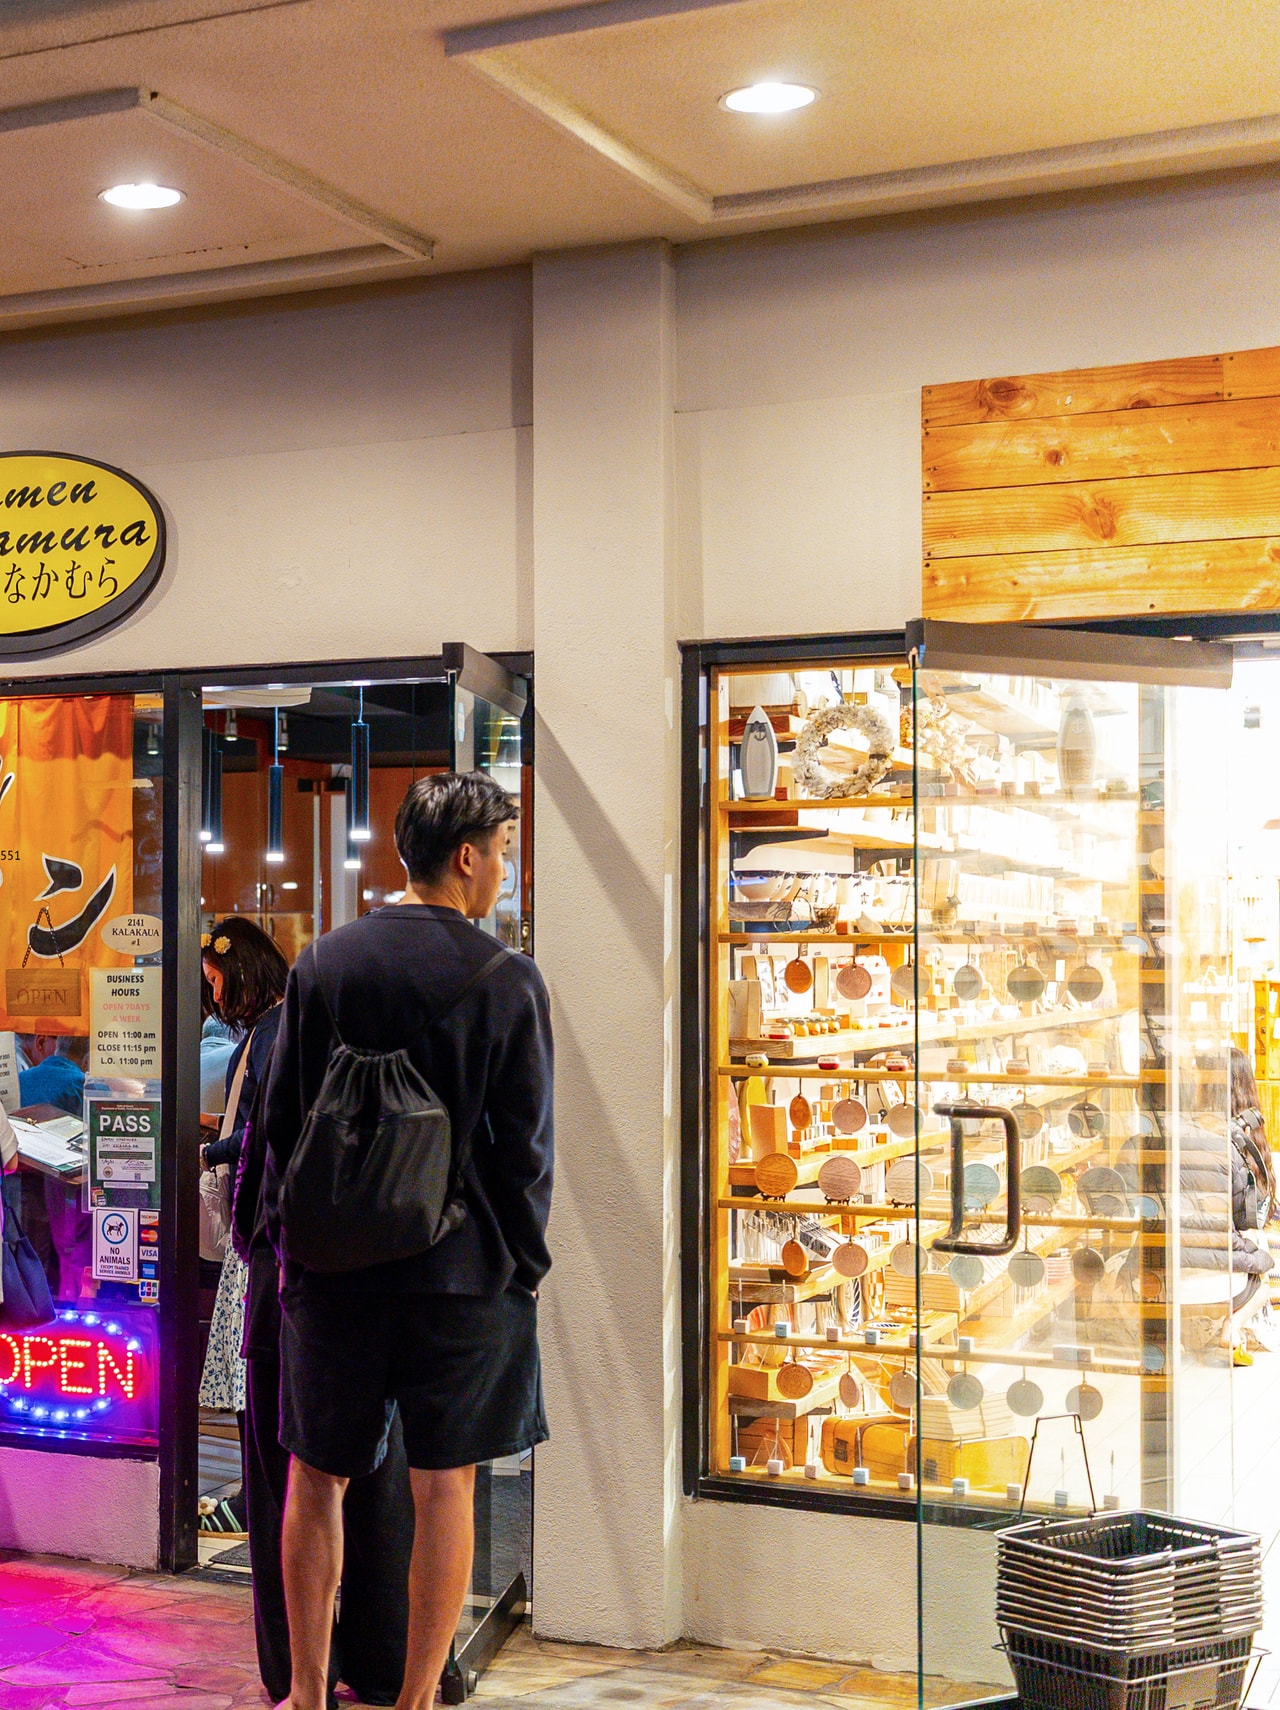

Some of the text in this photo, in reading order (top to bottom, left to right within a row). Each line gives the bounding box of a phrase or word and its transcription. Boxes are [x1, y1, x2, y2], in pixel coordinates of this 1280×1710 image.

[127, 918, 144, 927] 2141
[112, 928, 160, 936] KALAKAUA
[106, 975, 144, 983] BUSINESS
[111, 988, 140, 997] HOURS
[16, 988, 68, 1006] OPEN
[102, 1003, 123, 1011] OPEN
[122, 1031, 142, 1039] 11:00
[97, 1044, 156, 1054] CLOSE 11:15 pm
[140, 1059, 153, 1067] pm
[99, 1114, 151, 1133] PASS
[109, 1247, 120, 1255] NO
[141, 1249, 157, 1257] VISA
[99, 1255, 131, 1265] ANIMALS
